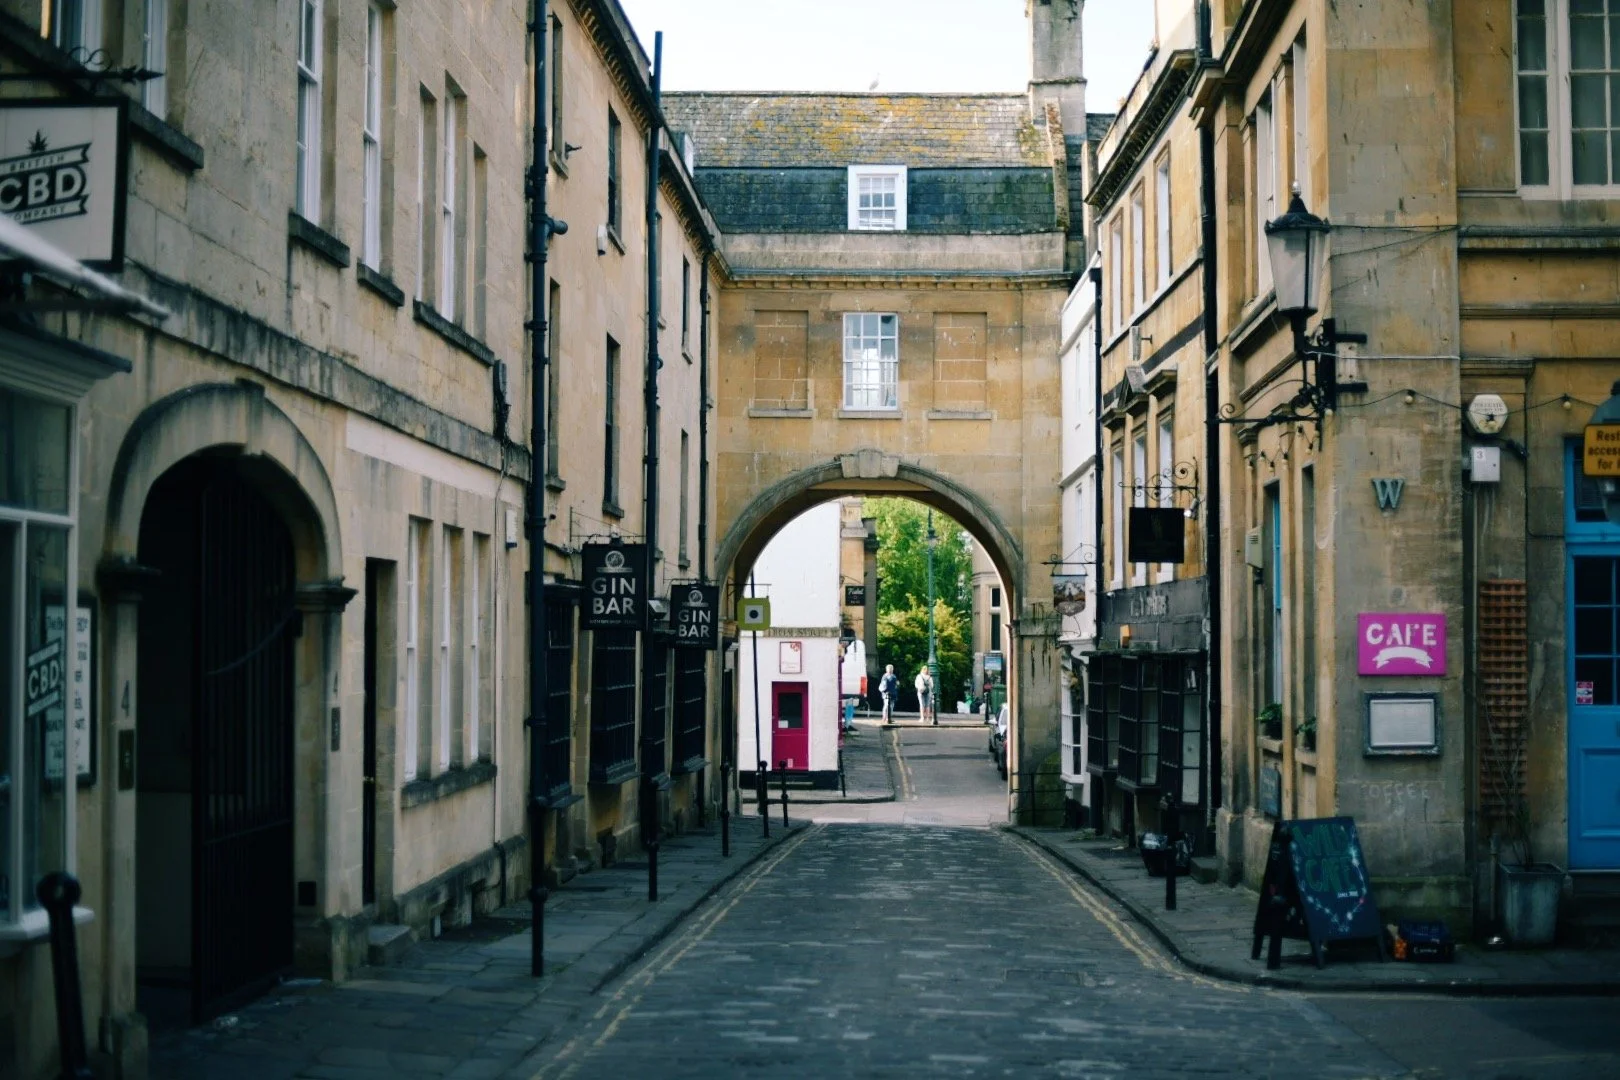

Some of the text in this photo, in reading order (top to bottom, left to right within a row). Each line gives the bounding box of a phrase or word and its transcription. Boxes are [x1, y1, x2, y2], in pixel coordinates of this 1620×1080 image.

[10, 156, 65, 171] BRITISH
[0, 166, 83, 211] CBD
[13, 206, 65, 219] OMPANY
[1476, 449, 1484, 460] 3
[1597, 458, 1613, 469] for
[1372, 479, 1404, 509] W
[591, 577, 636, 595] GIN
[592, 597, 636, 615] BAR
[679, 609, 711, 623] GIN
[679, 624, 710, 638] BAR
[1366, 623, 1437, 646] CAFE
[27, 659, 60, 701] CBD
